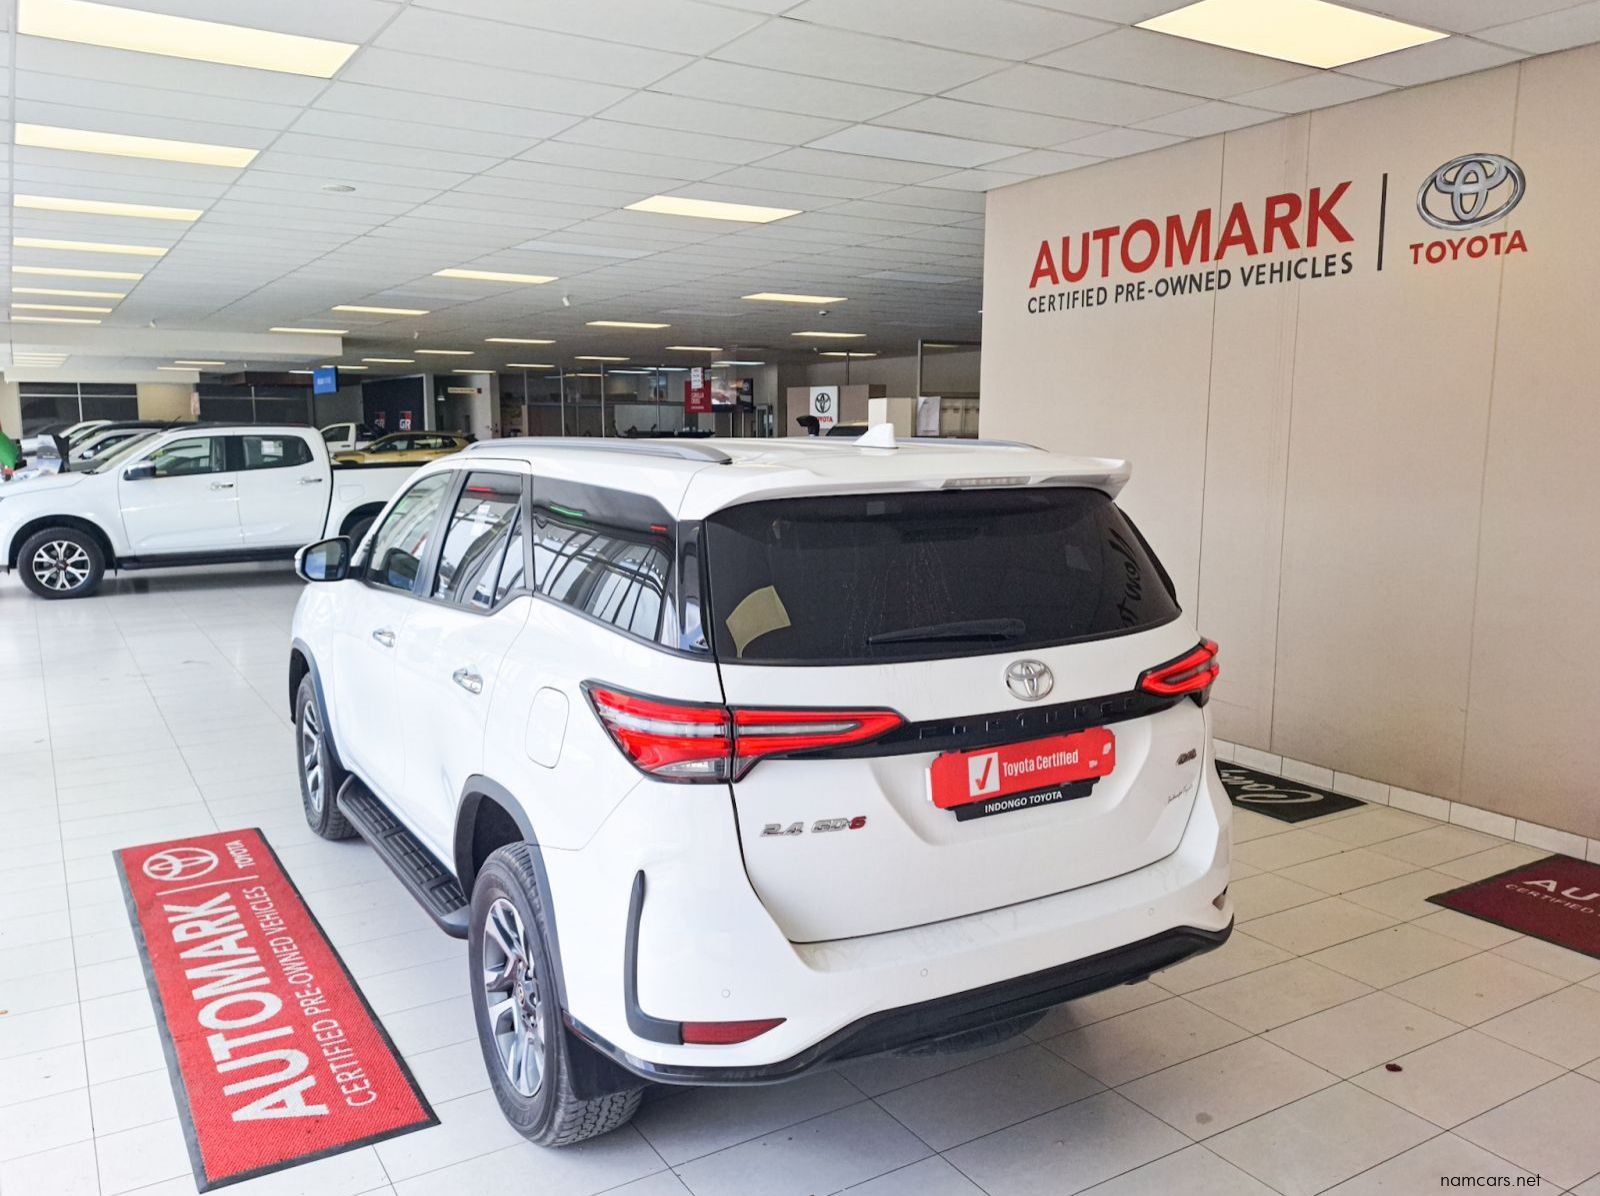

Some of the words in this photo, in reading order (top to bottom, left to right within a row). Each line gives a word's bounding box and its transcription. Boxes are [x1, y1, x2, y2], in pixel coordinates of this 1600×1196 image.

[1029, 181, 1354, 289] AUTOMARK
[1410, 229, 1528, 266] TOYOTA
[1028, 287, 1108, 314] CERTIFIED
[1115, 270, 1232, 304] PRE-OWNED
[1241, 252, 1353, 287] VEHICLES
[400, 419, 411, 430] GR
[1003, 759, 1034, 777] Toyota
[1036, 749, 1079, 771] Certified
[985, 797, 1027, 813] INDONGO
[1029, 790, 1063, 804] TOYOTA
[761, 821, 804, 836] 2.4
[225, 839, 255, 869] TOYOTA
[242, 884, 287, 936] VEHICLES
[1505, 883, 1595, 913] CERTIFIED
[268, 936, 331, 1017] PRE-OWNED
[163, 891, 330, 1123] AUTOMARK
[311, 1019, 378, 1107] CERTIFIED
